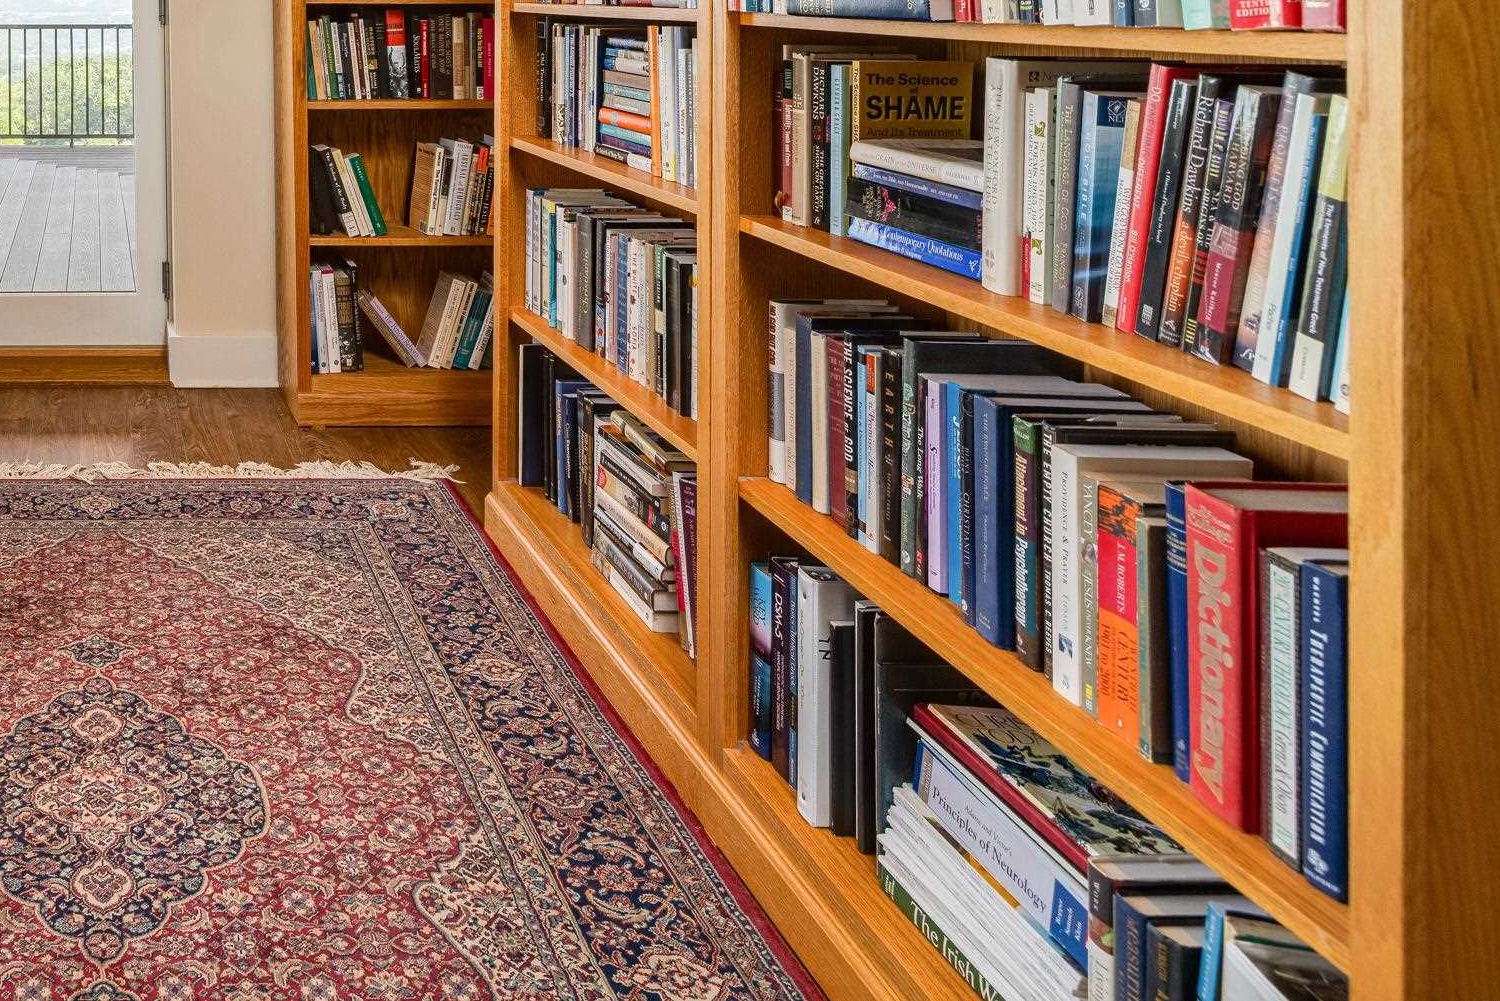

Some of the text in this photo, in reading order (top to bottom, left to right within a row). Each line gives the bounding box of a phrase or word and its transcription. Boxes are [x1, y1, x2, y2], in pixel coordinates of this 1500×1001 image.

[811, 67, 819, 120] DAWKINS
[866, 73, 959, 86] The Science
[866, 95, 964, 120] SHAME
[867, 126, 963, 137] And Its Treatment
[813, 145, 821, 169] SHOW
[814, 171, 819, 182] ON
[817, 150, 826, 209] THE GREATEST
[1059, 104, 1072, 232] THE LANGUAGE OF GOD
[1179, 95, 1215, 215] Richard Dawkins
[1035, 141, 1047, 233] SEAMUS HEANEY
[1078, 178, 1089, 220] BIBLE
[1174, 229, 1190, 266] devil's
[1308, 203, 1335, 336] The Elements of New Testament Greek
[769, 305, 776, 316] NO
[1165, 267, 1185, 313] chaplain
[883, 372, 894, 448] EARTH
[1043, 432, 1051, 455] THE
[1042, 461, 1051, 503] EMPTY
[962, 492, 970, 569] CHRISTIANITY
[1043, 508, 1051, 562] CHURCH
[1080, 483, 1093, 537] YANCEY
[1014, 452, 1027, 629] Attachment in Psychotherapy
[1043, 620, 1051, 654] REEVES
[1115, 631, 1129, 704] CENTURY
[1192, 539, 1234, 804] Dictionary
[1309, 629, 1327, 729] THERAPEUTIC
[967, 804, 980, 827] Adams
[1309, 731, 1327, 847] COMMUNICATION
[933, 784, 1043, 915] Principles of Neurology
[910, 902, 978, 988] The Irish
